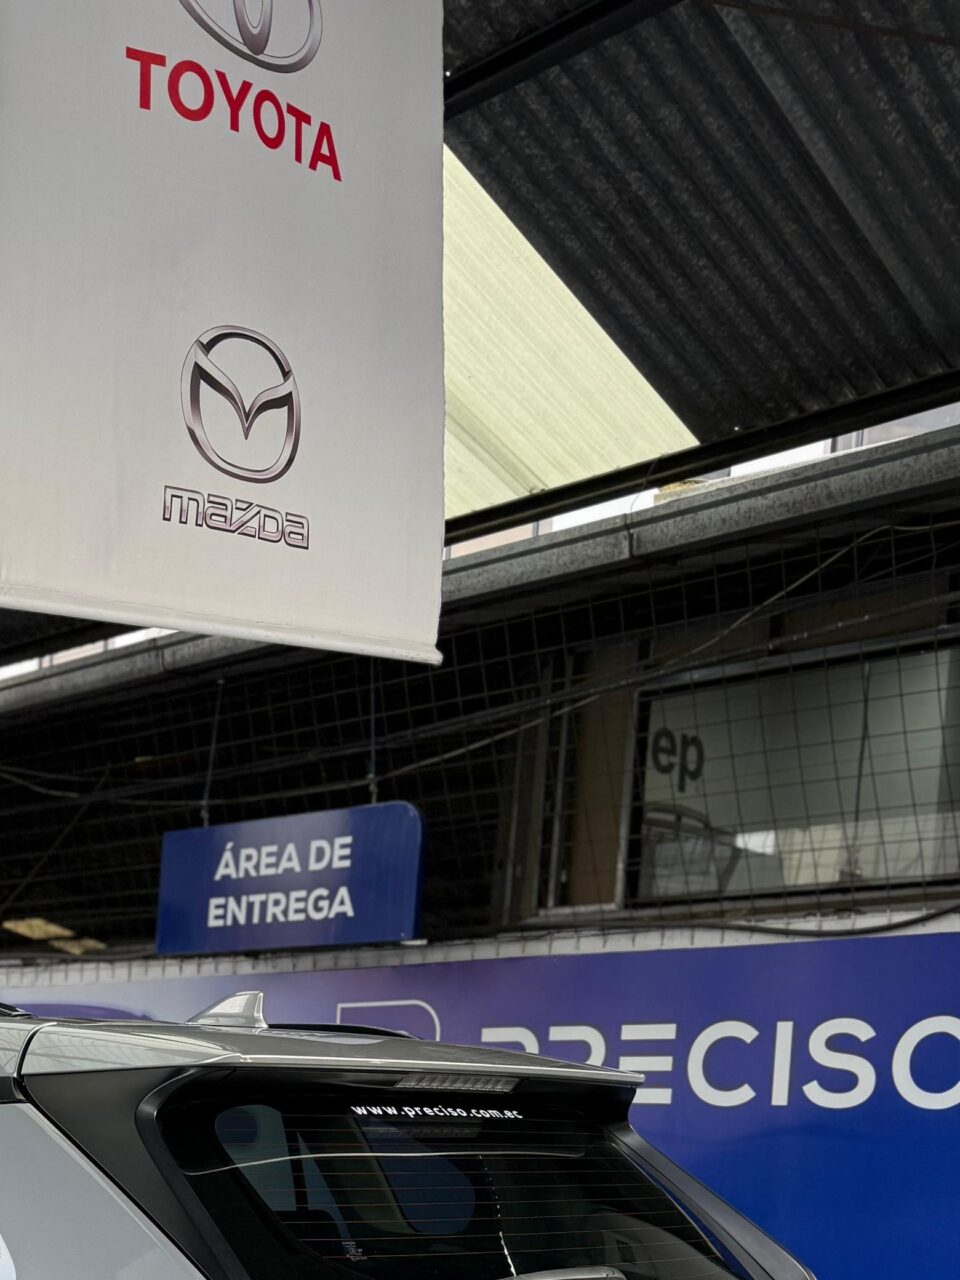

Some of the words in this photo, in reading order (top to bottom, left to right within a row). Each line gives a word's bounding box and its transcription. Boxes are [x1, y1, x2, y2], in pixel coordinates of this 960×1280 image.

[125, 46, 342, 182] TOYOTA
[162, 485, 310, 550] mazda
[652, 727, 704, 793] ep
[214, 841, 301, 881] ÁREA
[308, 835, 353, 872] DE
[207, 886, 355, 928] ENTREGA
[351, 1105, 523, 1119] www.preciso.com.ec
